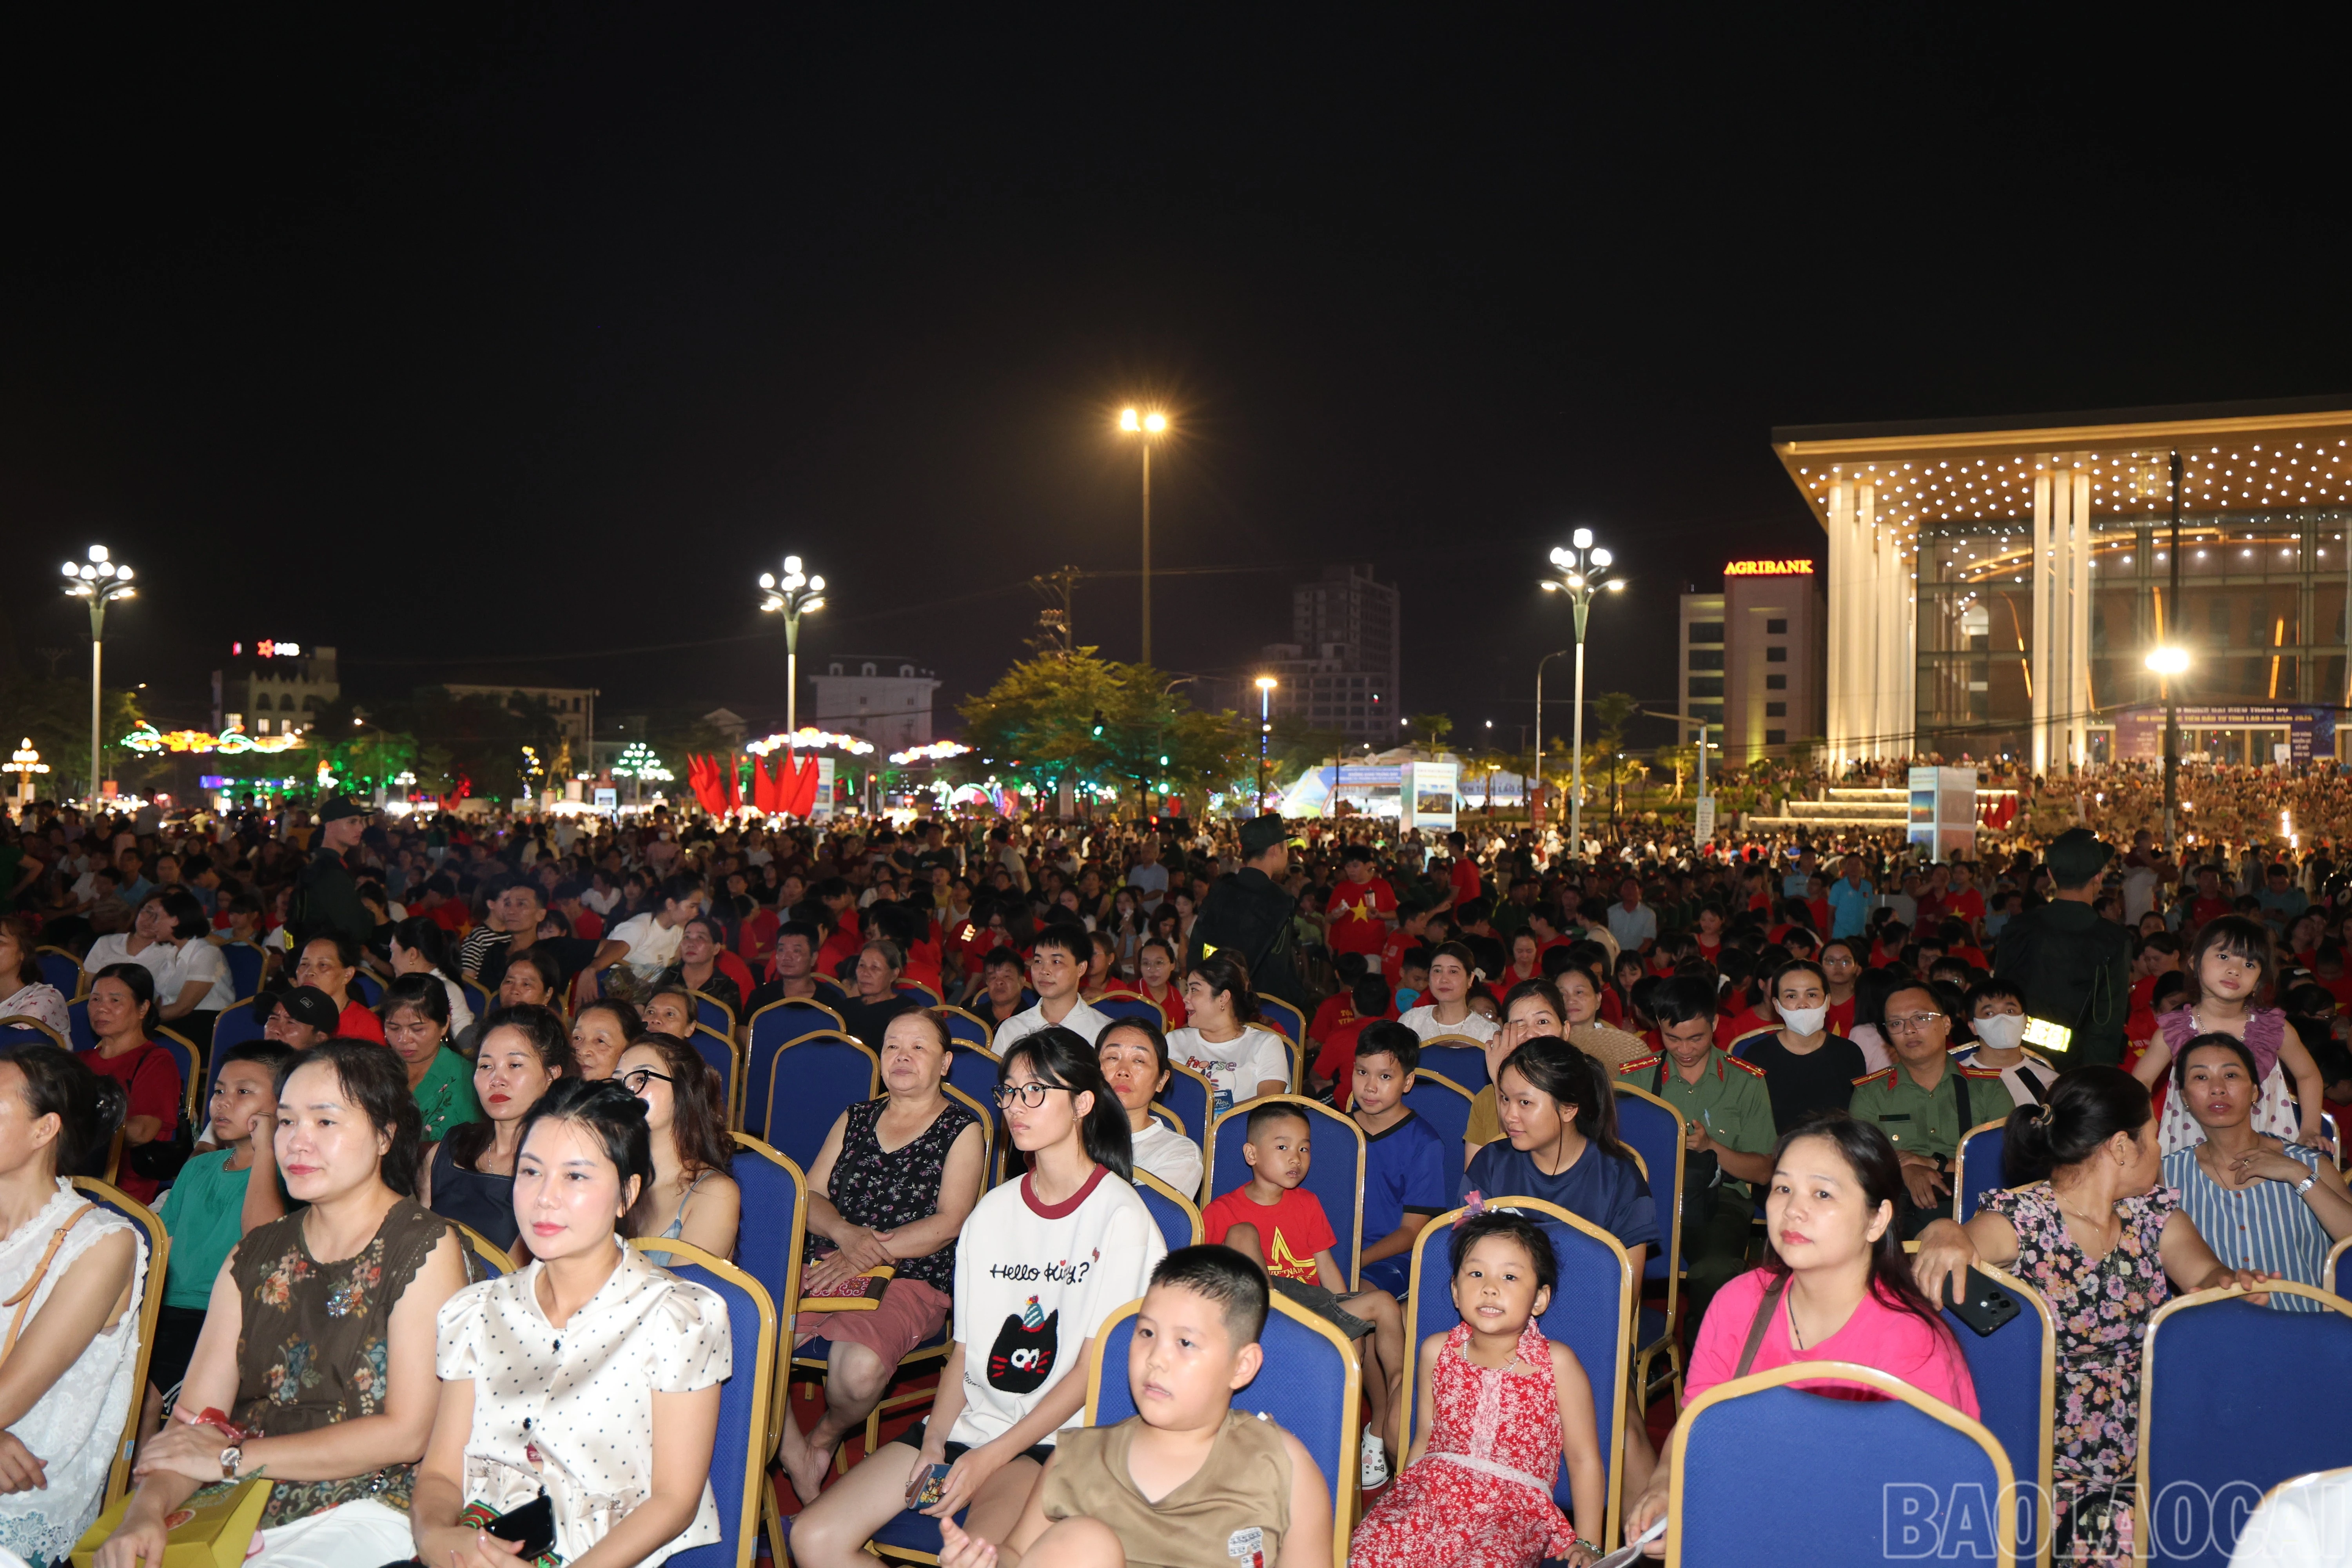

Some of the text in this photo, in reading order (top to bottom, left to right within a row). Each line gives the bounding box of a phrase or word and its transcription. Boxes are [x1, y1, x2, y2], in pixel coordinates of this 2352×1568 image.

[1724, 560, 1814, 575] AGRIBANK
[1185, 1056, 1237, 1071] horse
[990, 1261, 1090, 1285] Hello Kiy?
